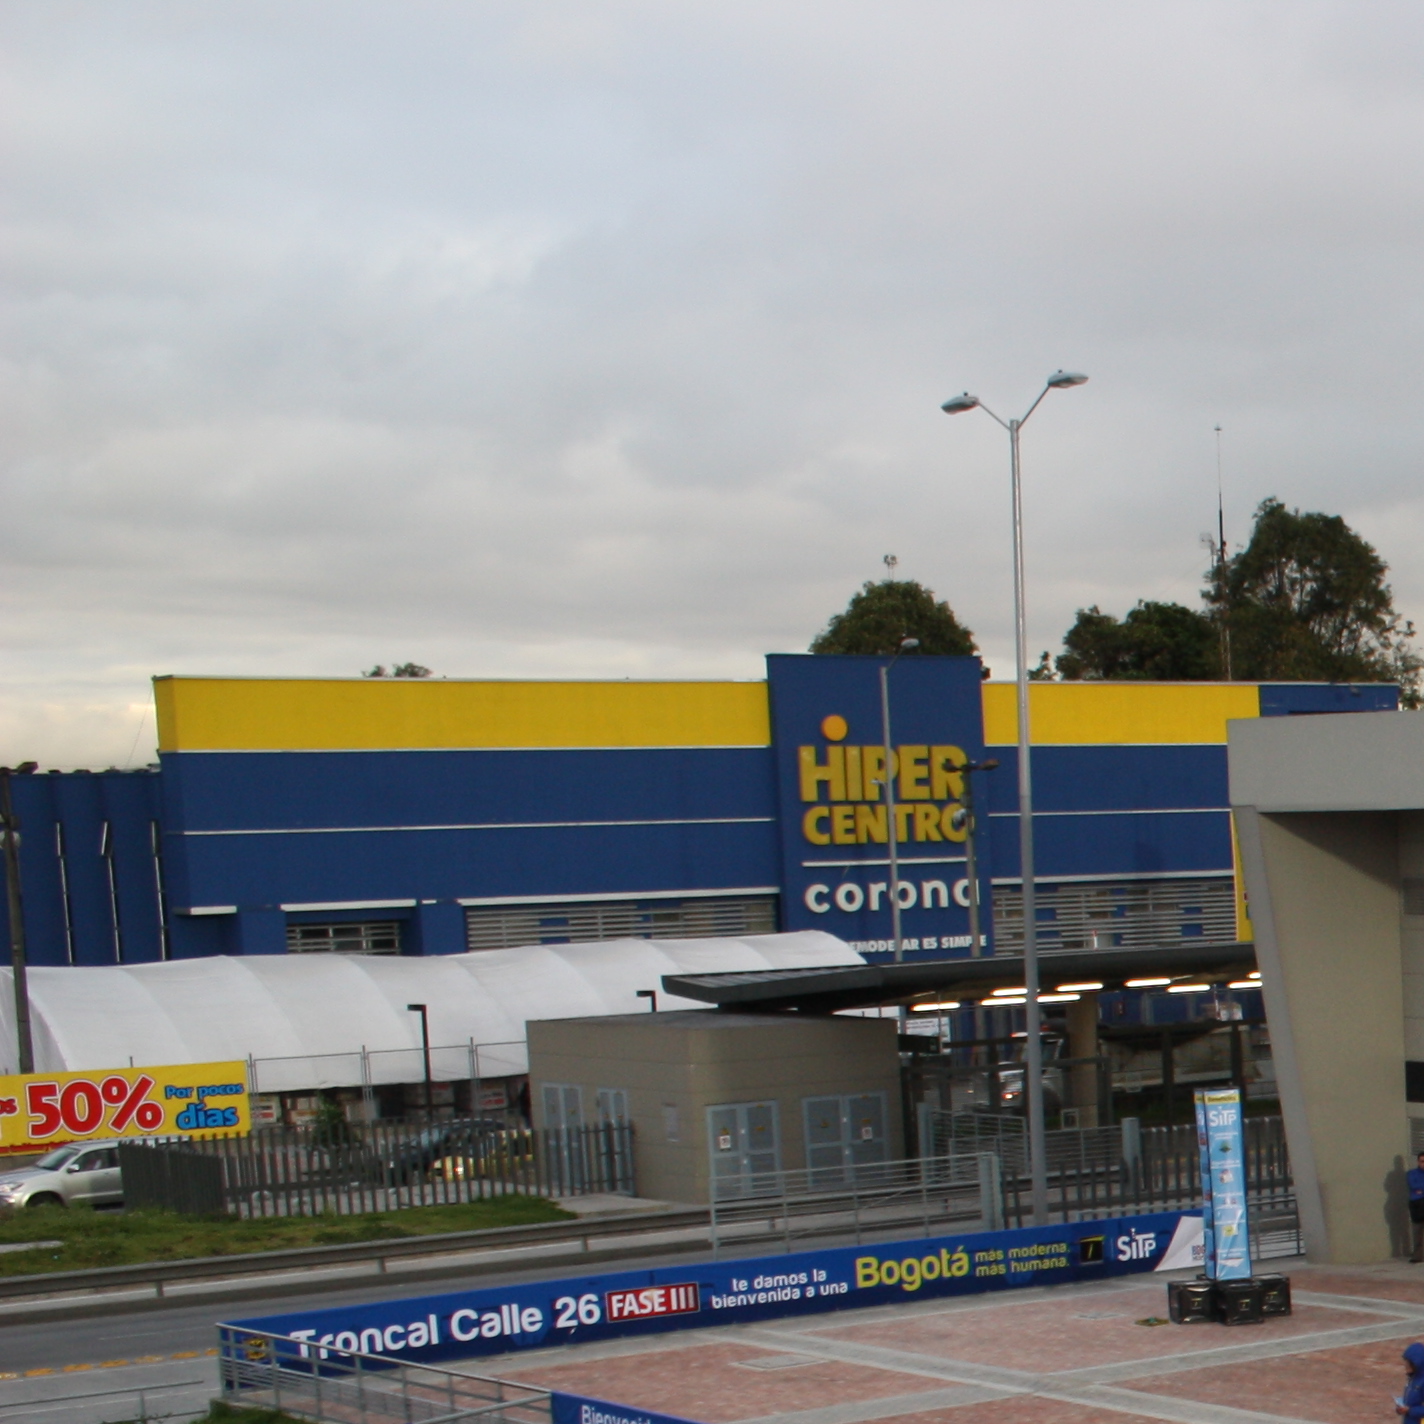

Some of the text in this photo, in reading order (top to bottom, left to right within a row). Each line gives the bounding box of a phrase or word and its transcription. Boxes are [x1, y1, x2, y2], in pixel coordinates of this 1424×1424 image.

[799, 744, 969, 802] HIPER
[803, 803, 975, 845] CENTRO
[804, 877, 979, 913] corona
[941, 935, 987, 948] SIMPE
[165, 1083, 244, 1099] Por pocos
[26, 1073, 165, 1138] 50%
[177, 1103, 239, 1130] días
[855, 1246, 970, 1291] Bogotá
[975, 1249, 1004, 1263] más
[976, 1262, 1006, 1277] más
[732, 1269, 827, 1292] te damos la
[711, 1282, 848, 1309] bienvenida a una
[290, 1314, 438, 1359] Troncal
[450, 1307, 543, 1342] Calle
[555, 1294, 601, 1329] 26
[611, 1291, 665, 1317] FASE
